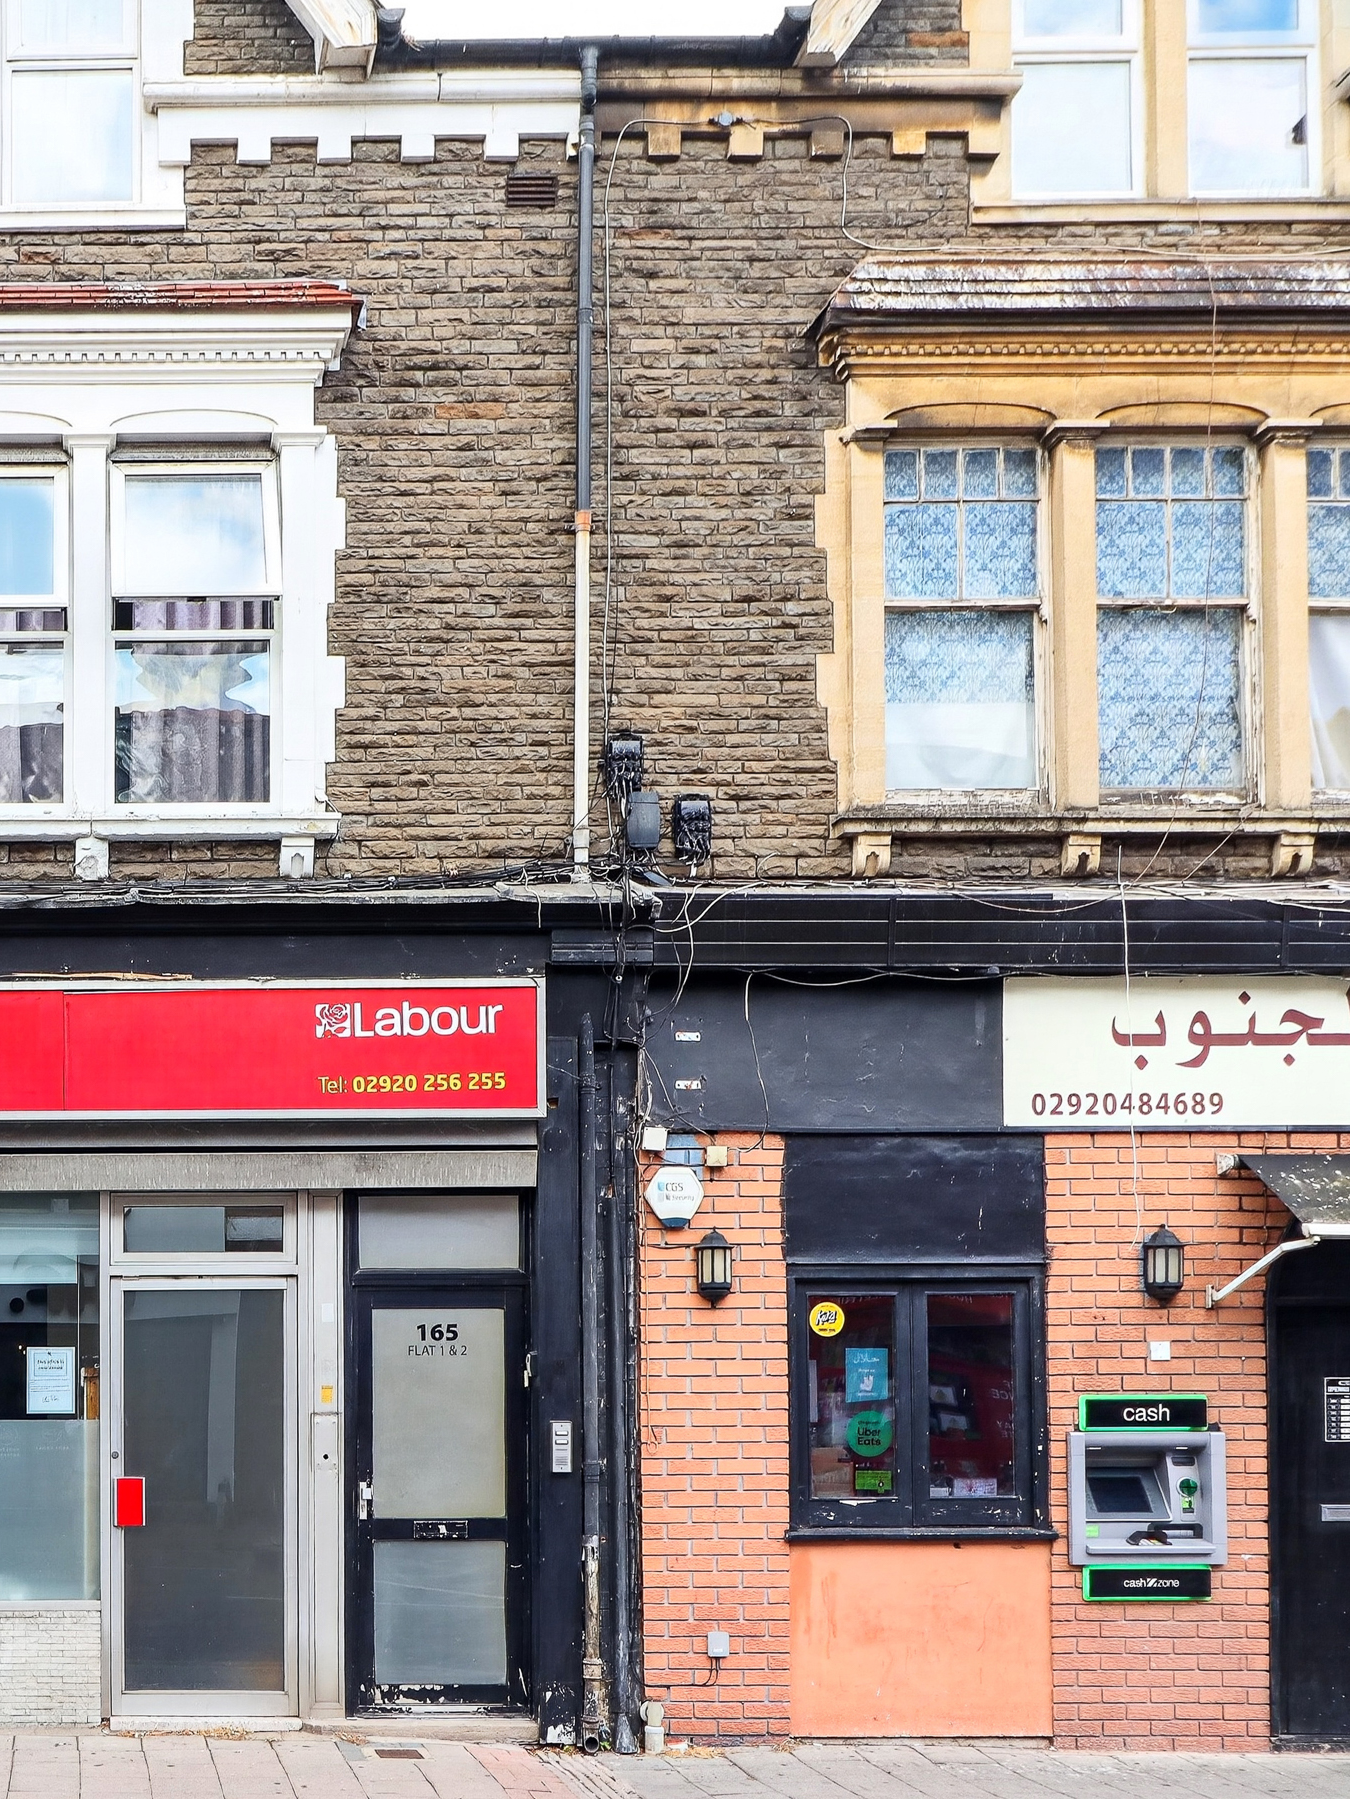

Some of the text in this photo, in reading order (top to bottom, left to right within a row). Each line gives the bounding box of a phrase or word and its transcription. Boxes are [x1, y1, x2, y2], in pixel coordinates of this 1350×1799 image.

[353, 1000, 504, 1037] Labour
[318, 1072, 506, 1094] Tel: 02920 256 255
[1031, 1092, 1225, 1116] 02920484689
[416, 1323, 459, 1341] 165
[408, 1345, 468, 1356] FLAT 1 & 2
[1123, 1403, 1170, 1422] cash
[857, 1427, 881, 1436] Uber
[857, 1437, 881, 1445] Eats
